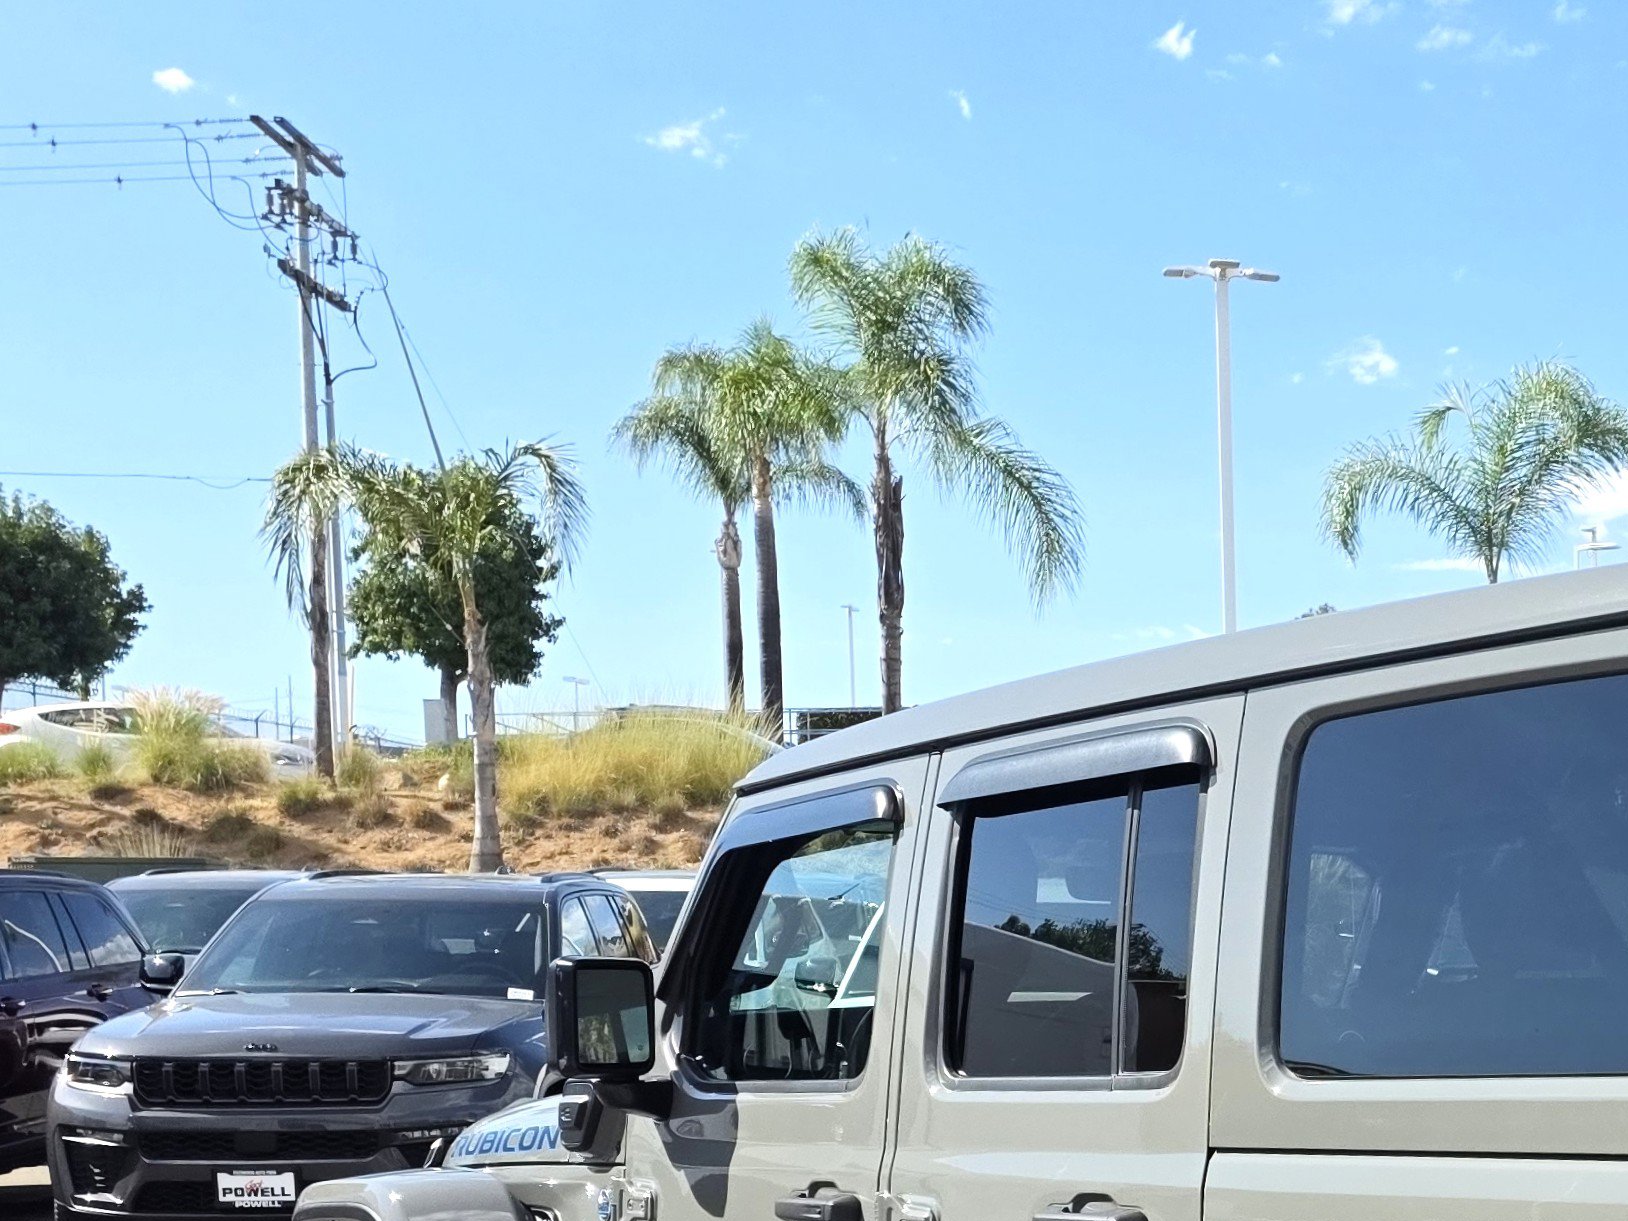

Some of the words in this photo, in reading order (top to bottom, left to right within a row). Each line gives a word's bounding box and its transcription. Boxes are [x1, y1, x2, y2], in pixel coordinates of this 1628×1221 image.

[451, 1126, 560, 1158] RUBICON
[222, 1186, 292, 1197] POWELL
[234, 1200, 282, 1208] POWELL
